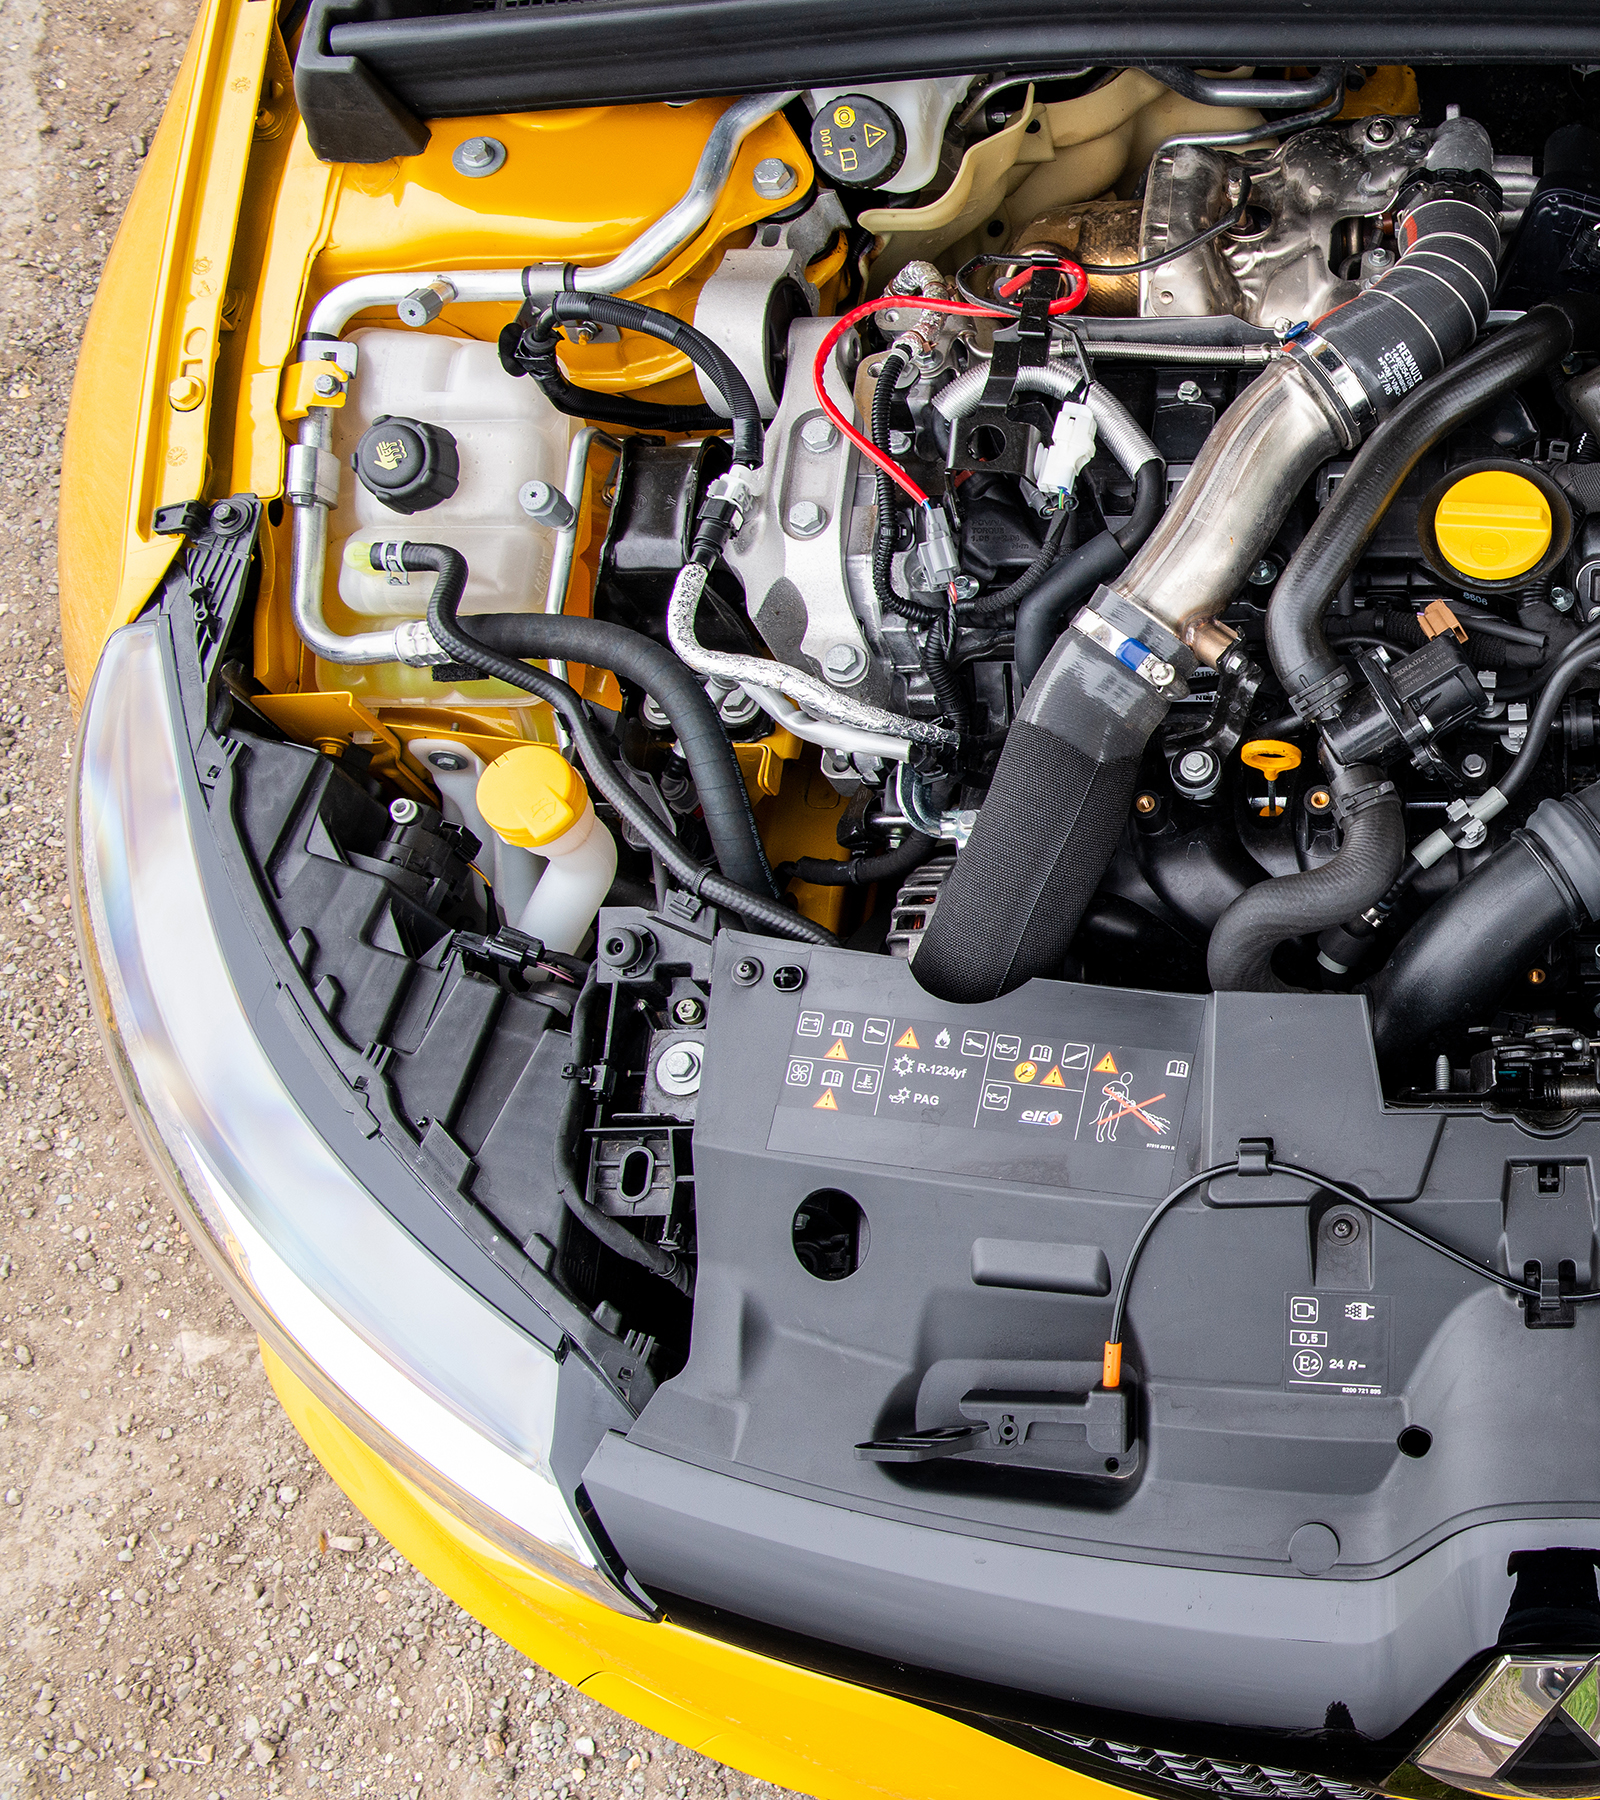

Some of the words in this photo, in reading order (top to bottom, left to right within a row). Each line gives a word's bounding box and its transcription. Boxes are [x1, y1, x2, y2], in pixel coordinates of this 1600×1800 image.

[819, 128, 832, 148] DOT
[1384, 352, 1396, 364] CT
[1395, 341, 1423, 383] RENAULT
[758, 850, 773, 882] SUCTION
[917, 1062, 968, 1079] R-1234yf
[913, 1092, 940, 1106] PAG
[1021, 1109, 1048, 1123] elf
[1299, 1333, 1319, 1345] 0,5
[1298, 1355, 1319, 1372] E2
[1329, 1359, 1344, 1370] 24
[1341, 1386, 1357, 1394] 8200
[1358, 1387, 1369, 1395] 721
